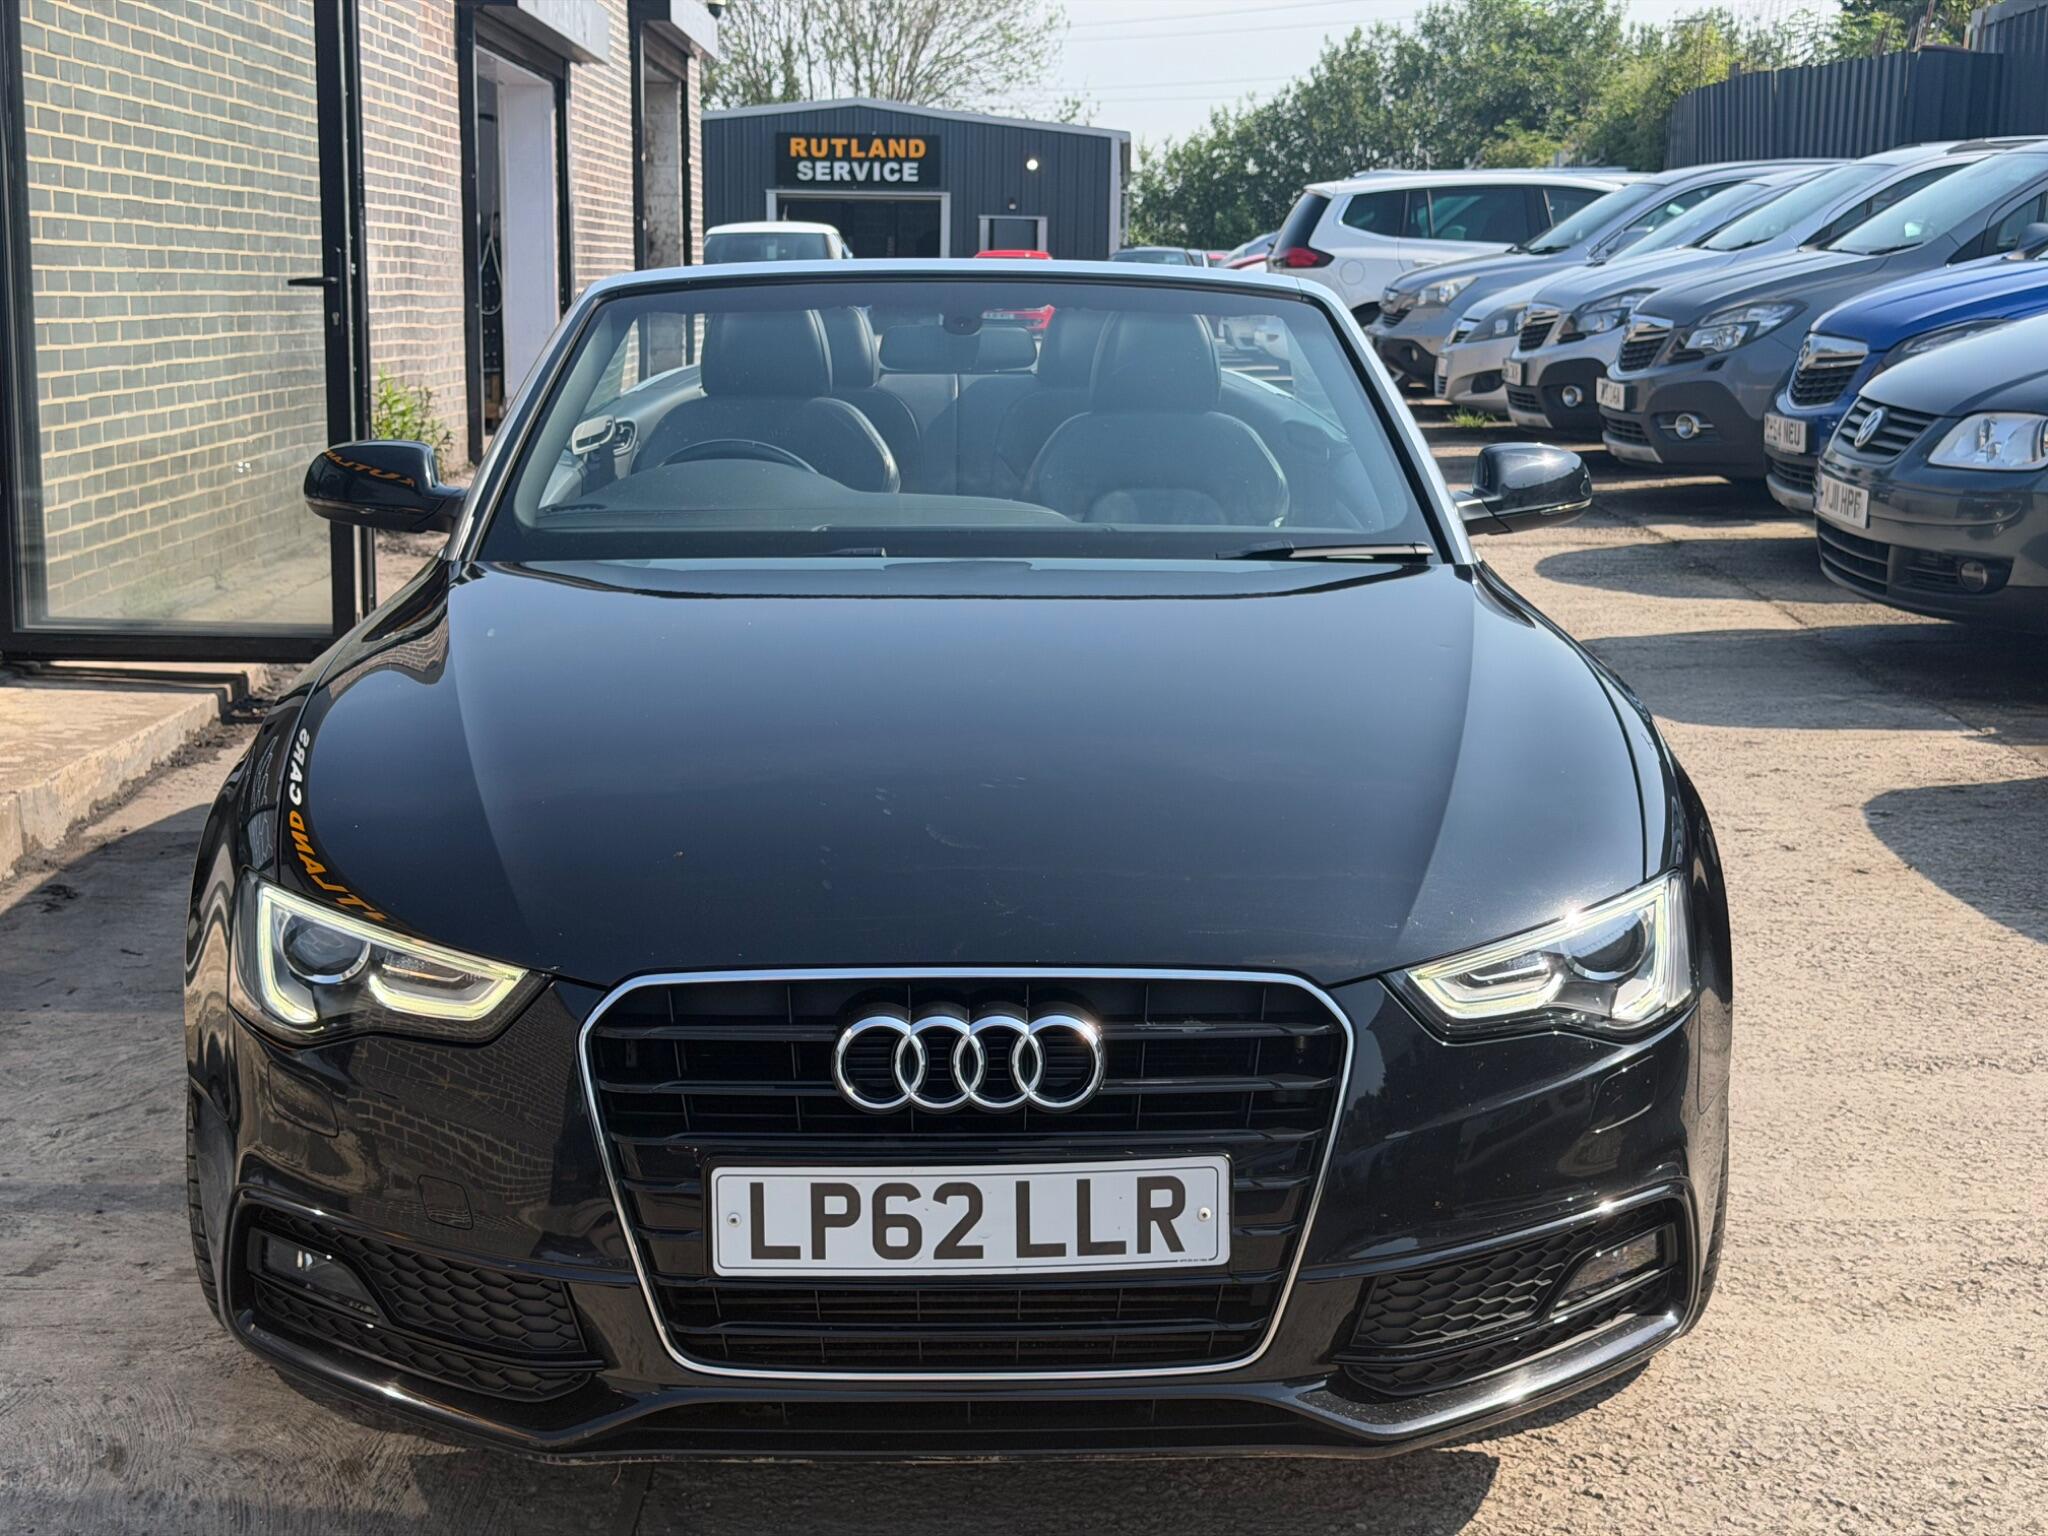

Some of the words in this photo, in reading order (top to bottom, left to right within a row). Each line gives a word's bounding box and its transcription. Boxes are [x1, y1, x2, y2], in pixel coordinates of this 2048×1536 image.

[789, 137, 926, 158] RUTLAND
[796, 161, 919, 182] SERVICE
[749, 1181, 984, 1261] LP62
[1015, 1175, 1186, 1259] LLR
